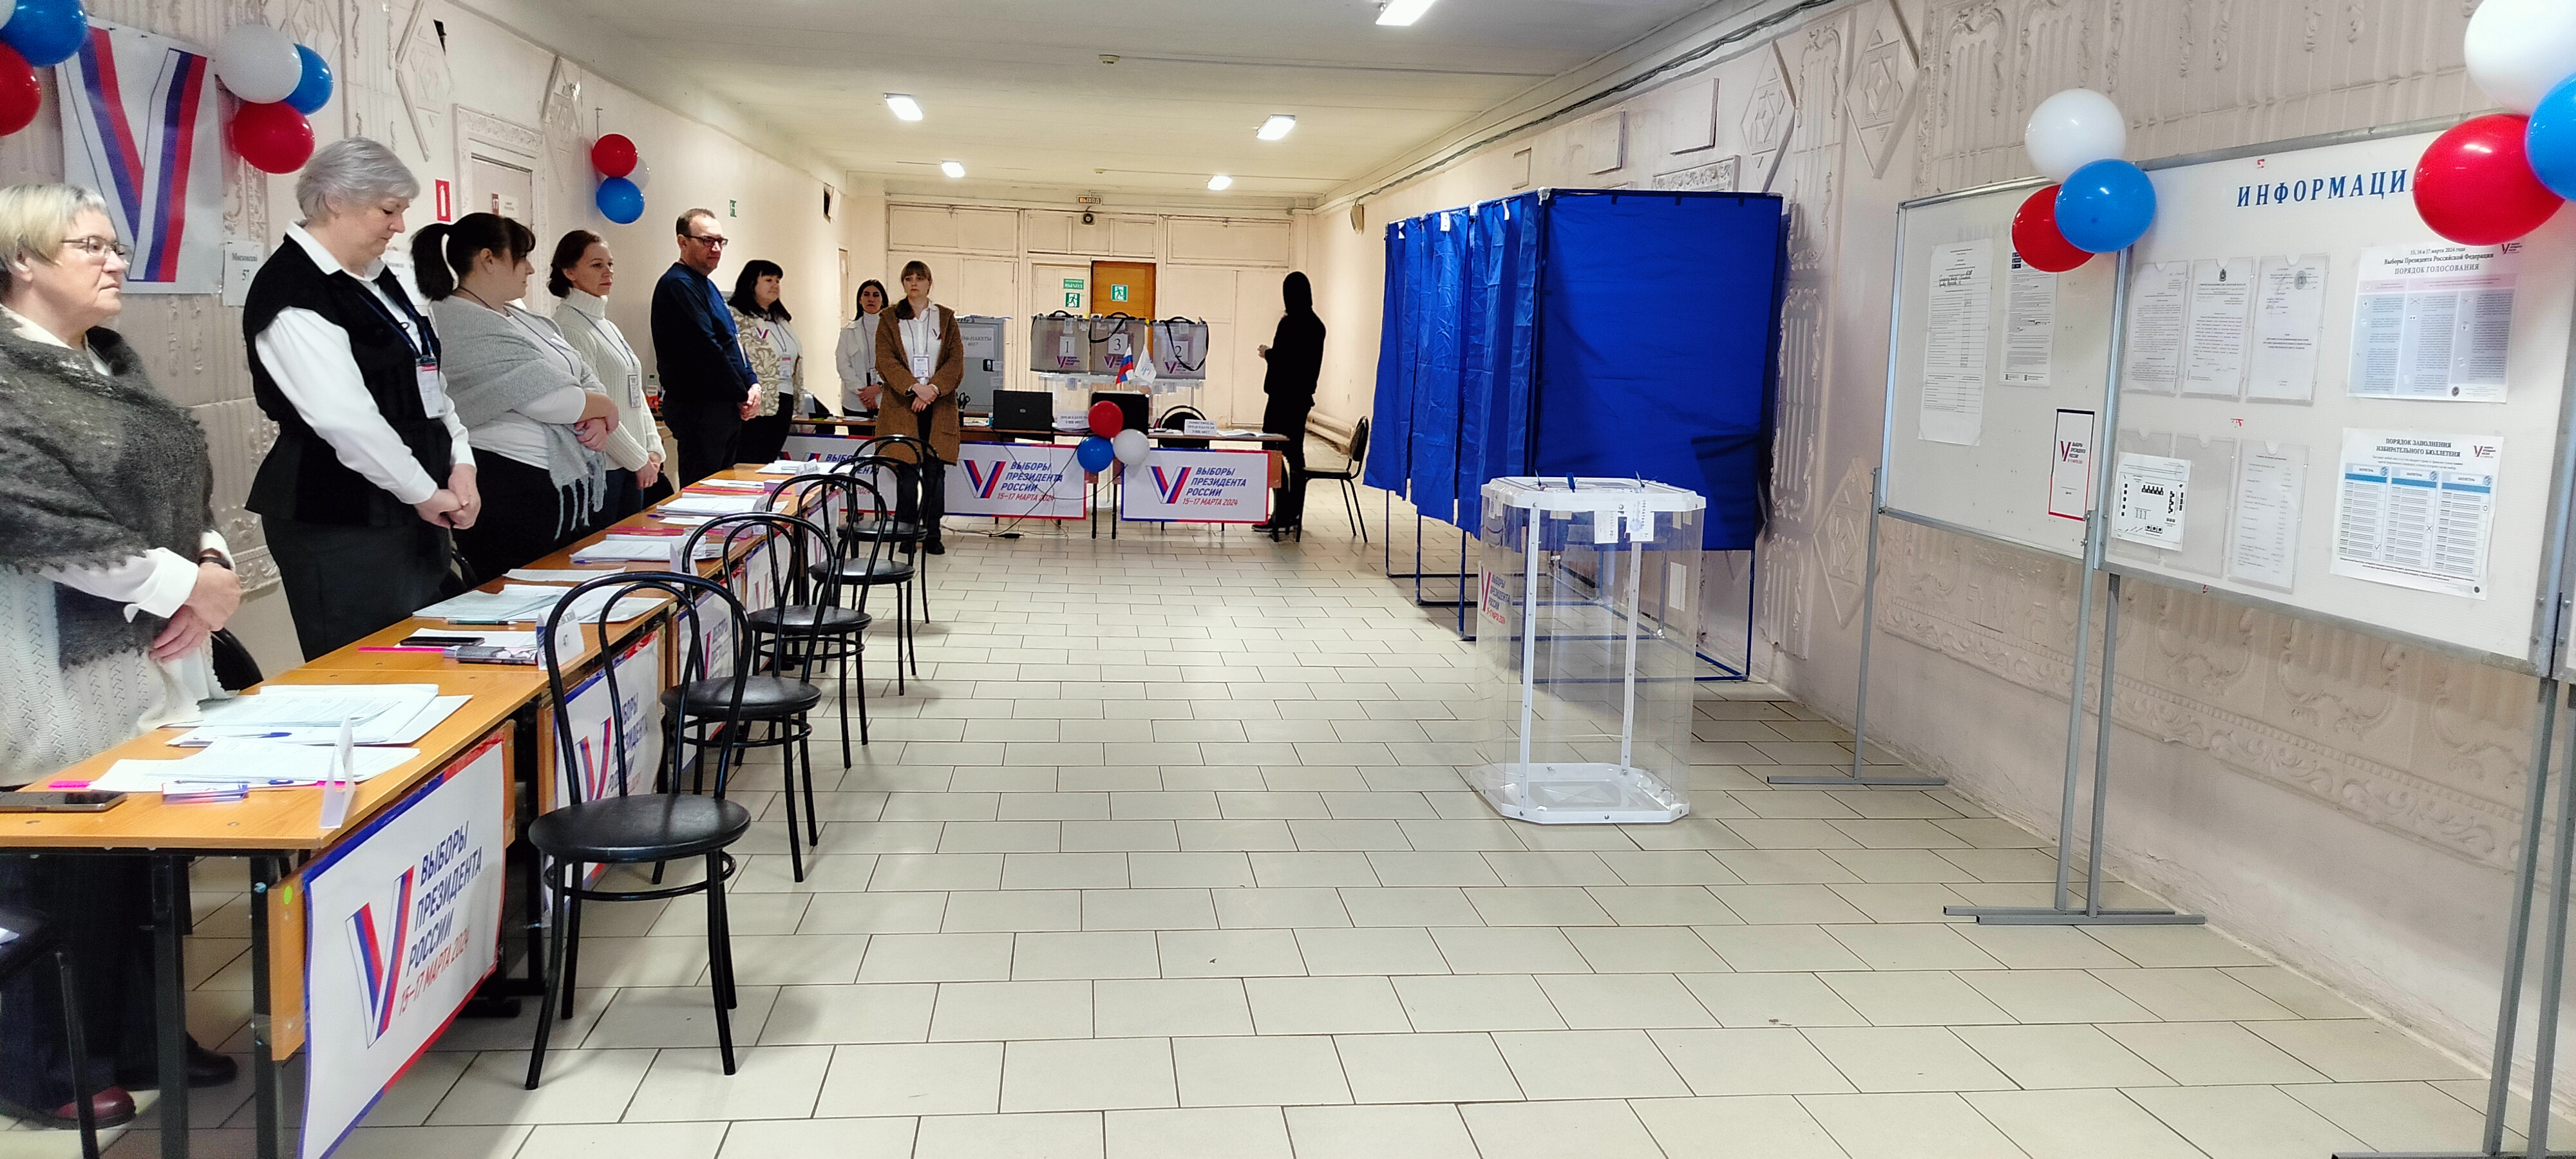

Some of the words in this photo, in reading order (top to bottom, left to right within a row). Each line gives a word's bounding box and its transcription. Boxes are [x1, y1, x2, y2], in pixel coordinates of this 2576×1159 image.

[2237, 169, 2412, 207] ИНФОРМАЦИ
[2427, 263, 2479, 273] ГОЛОСОВАНИЯ
[1066, 341, 1069, 353] 1
[1113, 338, 1121, 351] 3
[1175, 345, 1182, 358] 2
[2376, 446, 2424, 455] ИЗБИРАТЕЛЬНОГО
[1010, 461, 1051, 471] ВЫБОРЫ
[1195, 467, 1236, 476] ВЫБОРЫ
[1005, 472, 1063, 482] ПРЕЗИДЕНТА
[1191, 477, 1247, 487] ПРЕЗИДЕНТА
[1000, 483, 1038, 491] РОССИИ
[1186, 488, 1222, 496] РОССИИ
[420, 820, 469, 887] ВЫБОРЫ
[415, 845, 482, 932] ПРЕЗИДЕНТА
[406, 907, 455, 977] РОССИИ
[425, 943, 451, 987] МАРТА
[451, 925, 469, 963] 2024
